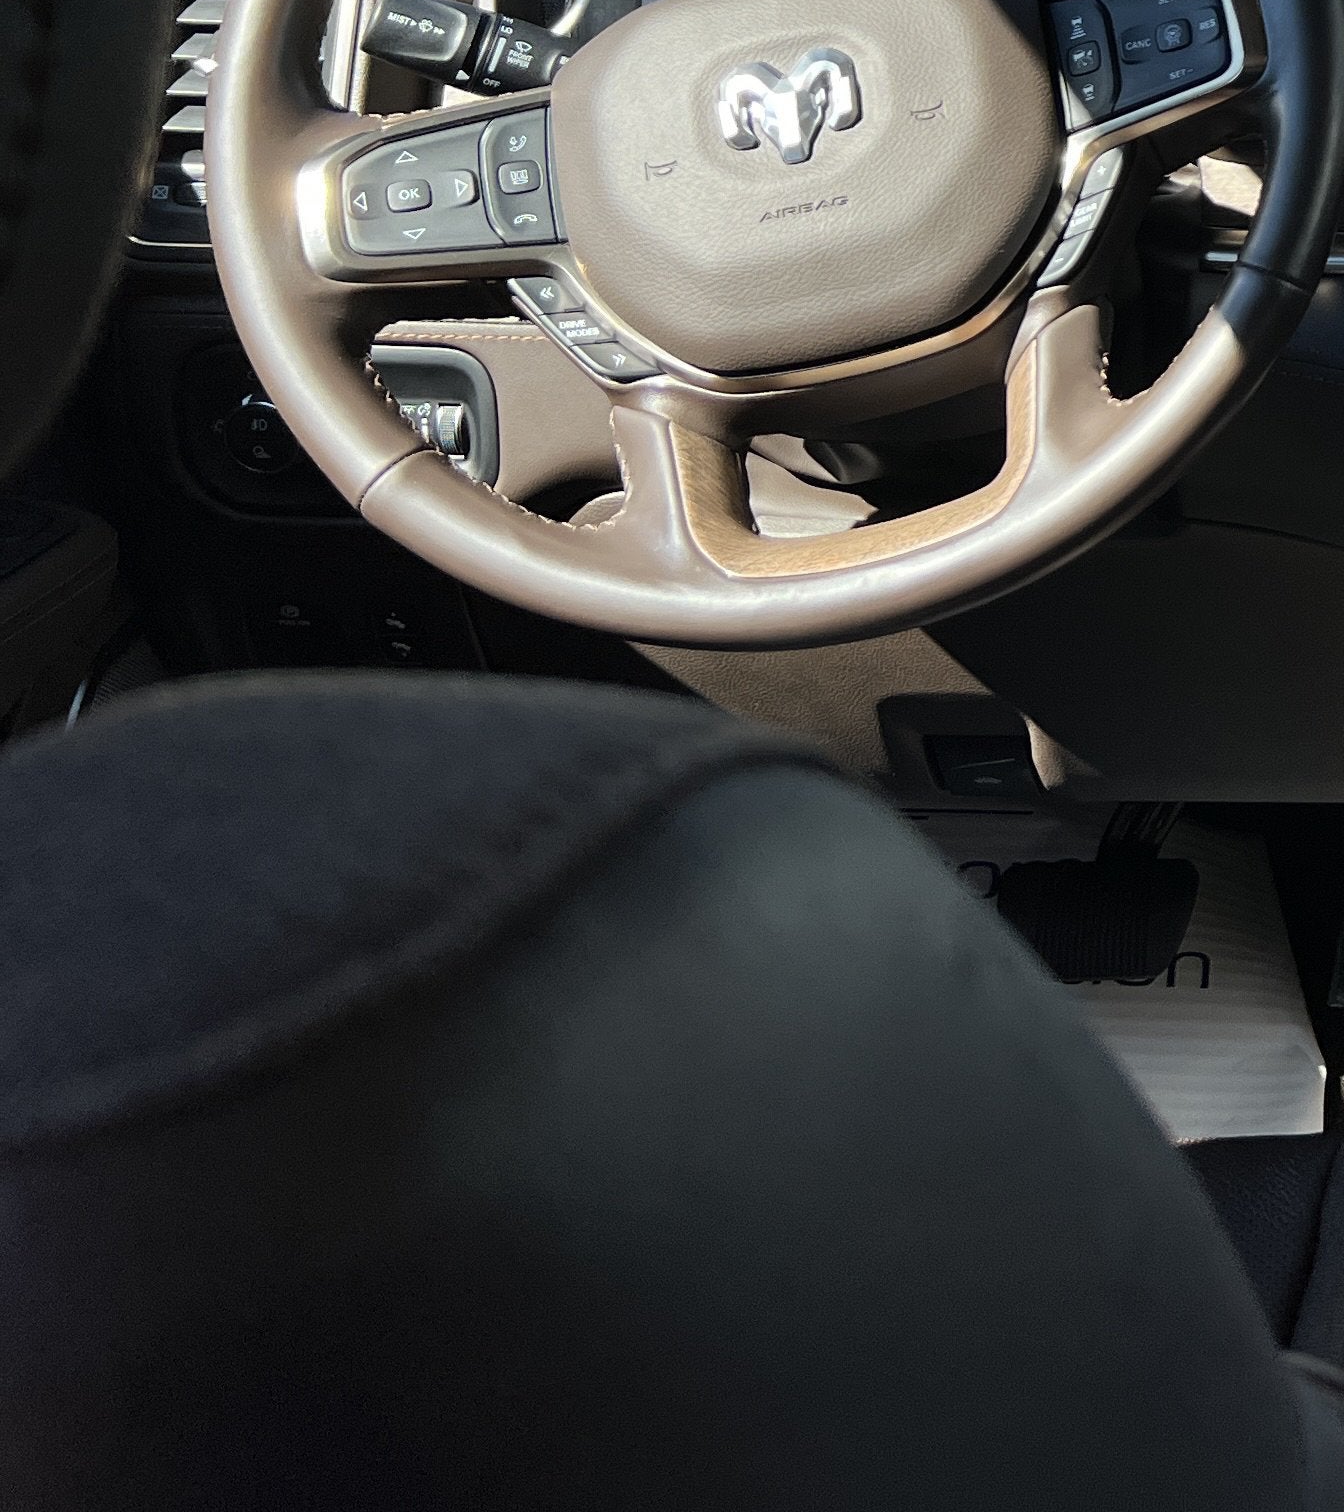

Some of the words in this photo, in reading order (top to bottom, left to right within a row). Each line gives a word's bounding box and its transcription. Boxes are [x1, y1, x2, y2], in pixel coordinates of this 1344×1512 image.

[387, 11, 411, 26] MIST
[1199, 17, 1217, 31] RES
[1125, 38, 1151, 51] CANC
[508, 49, 534, 61] FRONT
[483, 77, 501, 87] OFF
[398, 187, 421, 201] OK
[760, 196, 849, 223] AIRBAG
[558, 319, 587, 329] DRIVE
[566, 326, 600, 338] MODES
